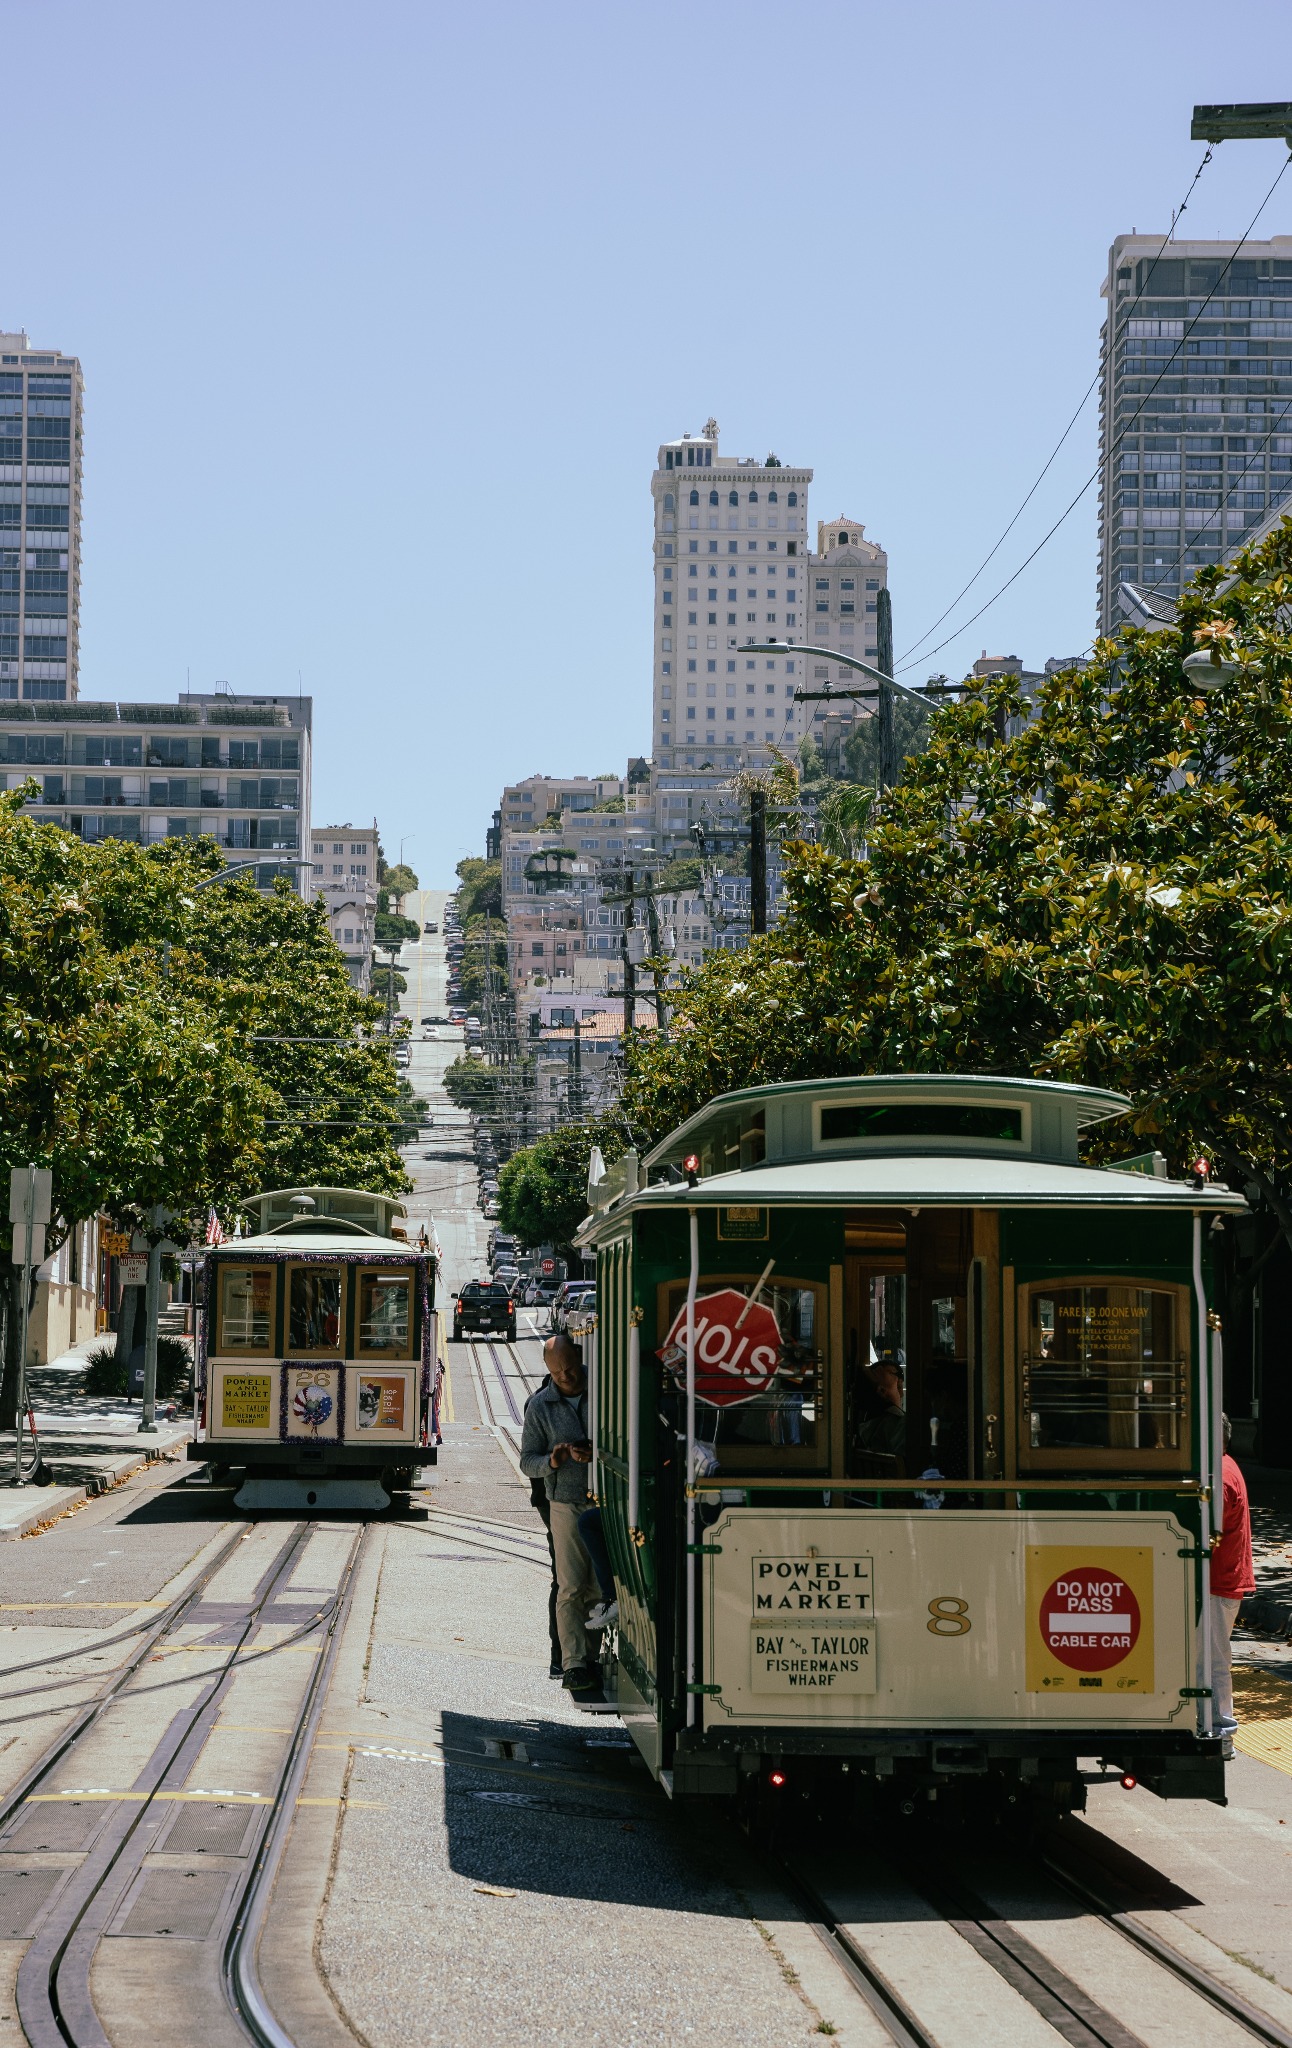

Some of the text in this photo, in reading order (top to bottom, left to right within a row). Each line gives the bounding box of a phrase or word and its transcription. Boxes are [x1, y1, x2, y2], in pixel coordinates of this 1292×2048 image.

[120, 1258, 128, 1266] NO
[1112, 1307, 1130, 1318] ONE
[1130, 1307, 1149, 1318] WAY
[674, 1316, 777, 1386] STOP
[226, 1378, 269, 1386] POWELL
[296, 1371, 331, 1387] 26
[225, 1390, 269, 1398] MARKET
[225, 1404, 236, 1412] BAY
[246, 1404, 269, 1413] TAYLOR
[758, 1562, 869, 1578] POWELL
[787, 1579, 841, 1591] AND
[1056, 1581, 1124, 1597] DO NOT
[756, 1594, 870, 1609] MARKET
[1067, 1597, 1113, 1612] PASS
[927, 1596, 971, 1636] 8
[756, 1636, 869, 1655] BAY AND TAYLOR
[1049, 1635, 1131, 1648] CABLE CAR
[766, 1659, 859, 1672] FISHERMANS
[788, 1674, 837, 1686] WHARF
